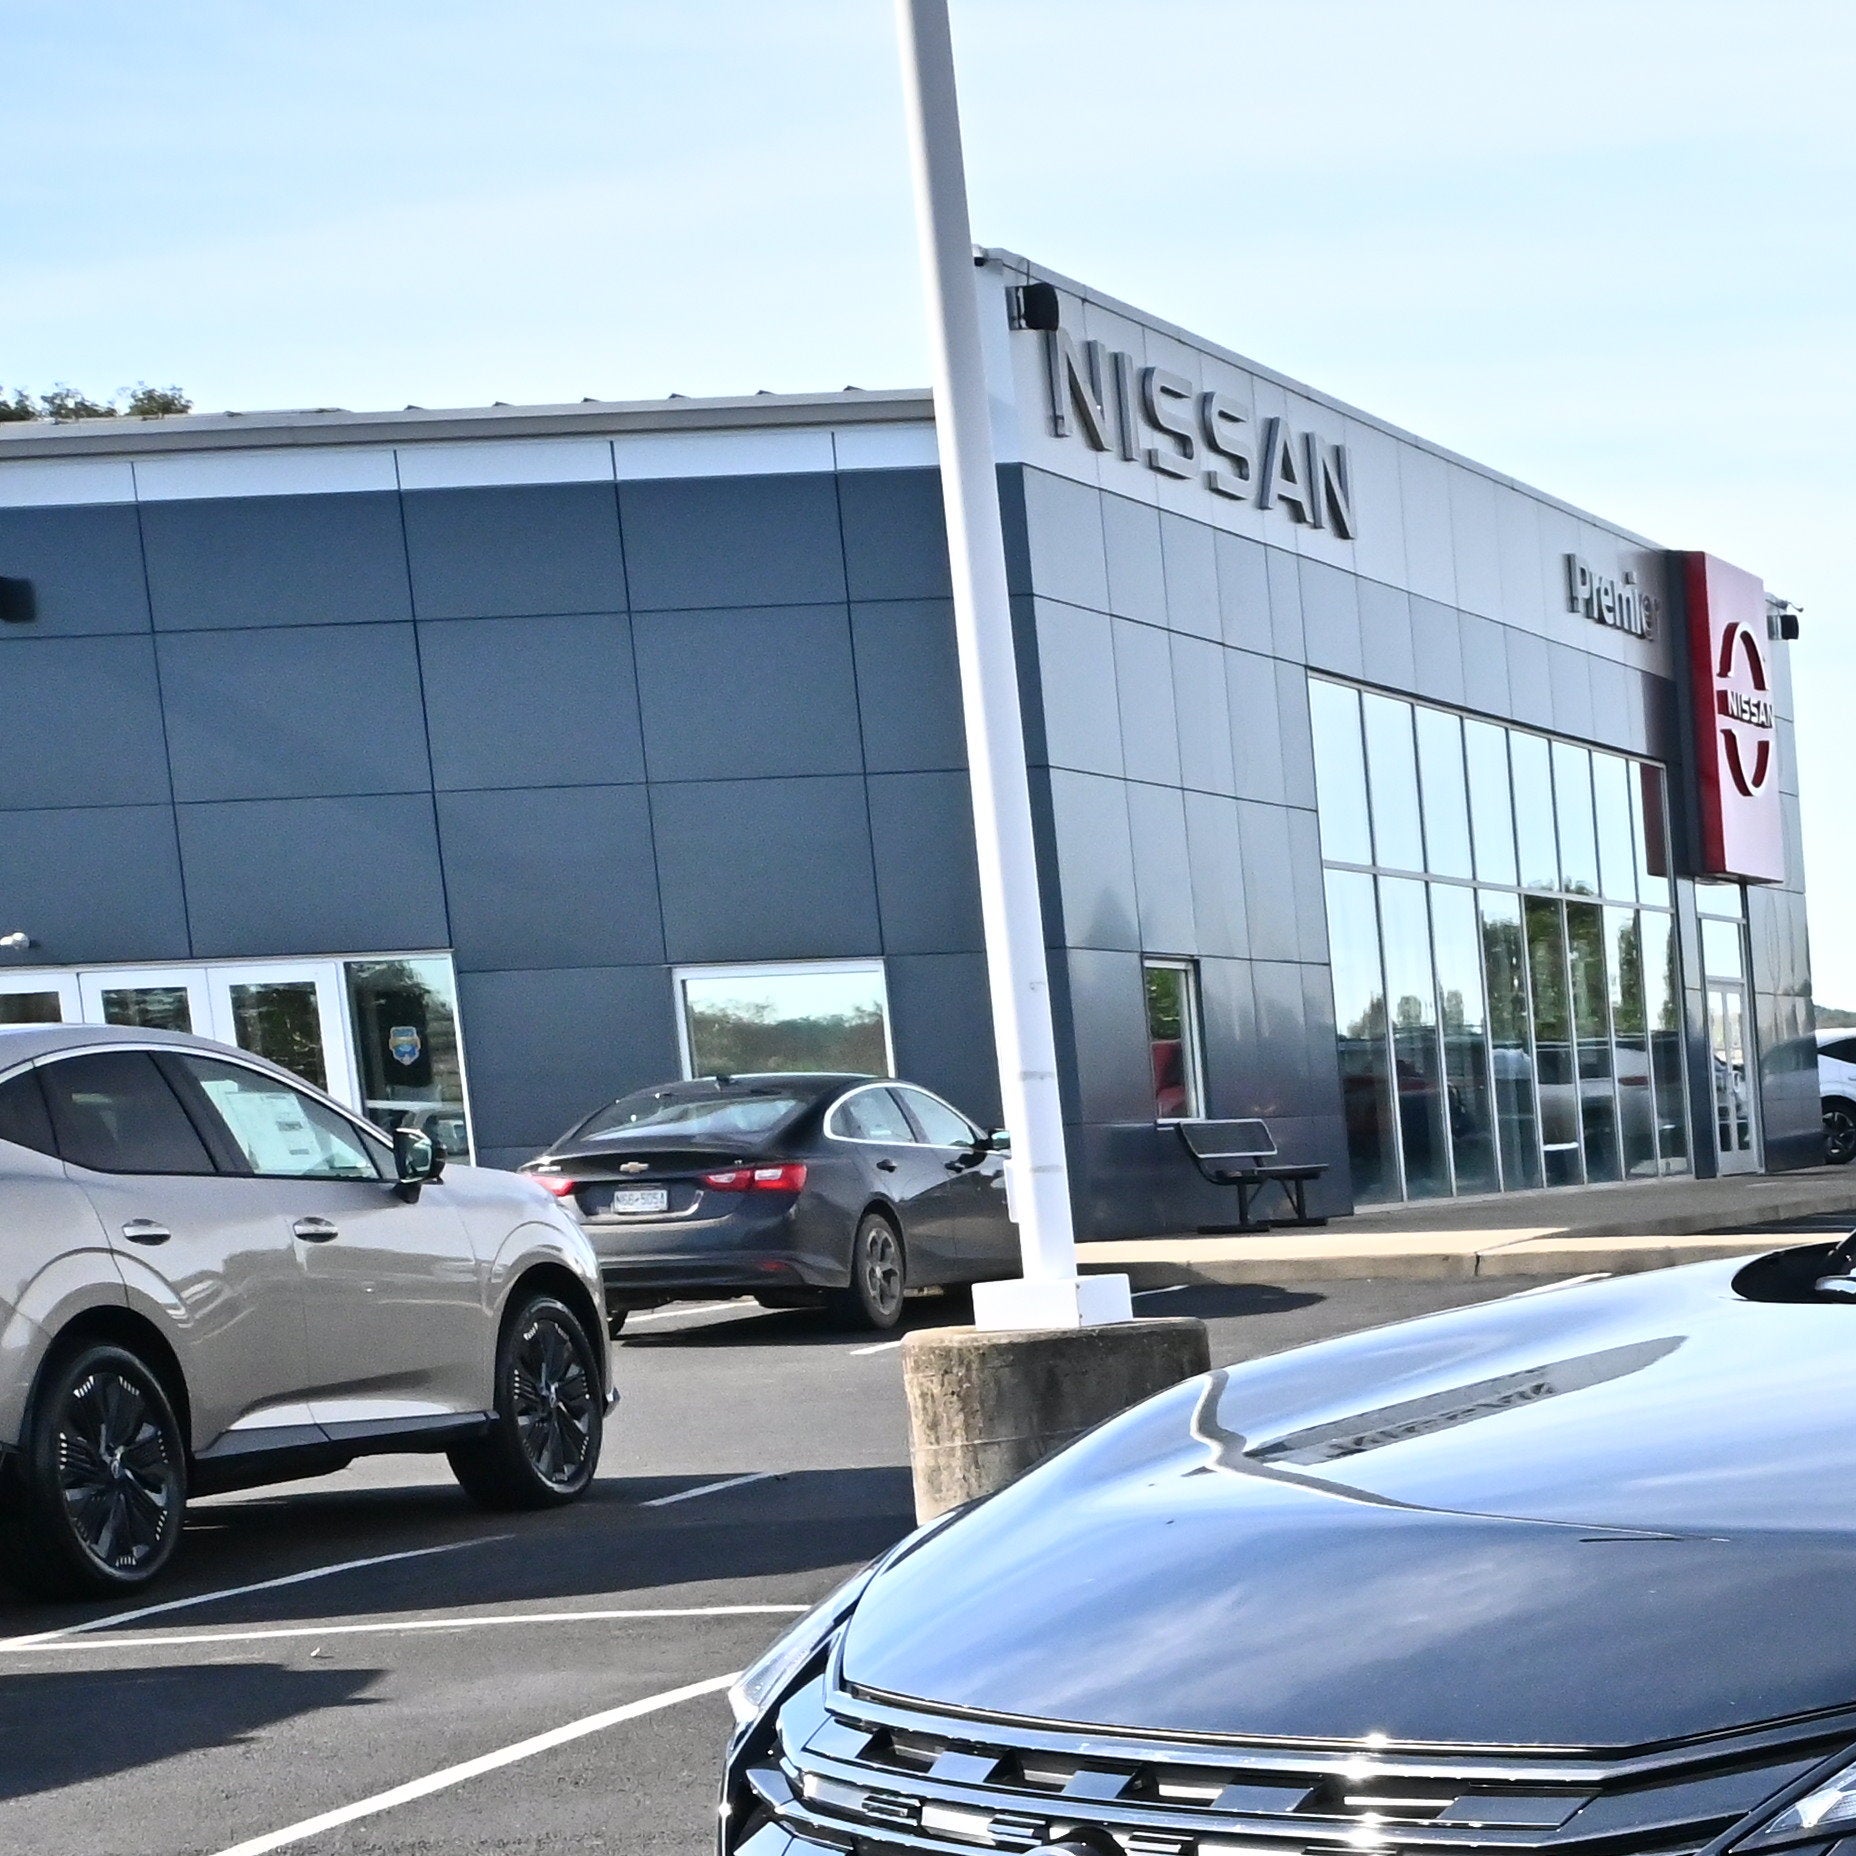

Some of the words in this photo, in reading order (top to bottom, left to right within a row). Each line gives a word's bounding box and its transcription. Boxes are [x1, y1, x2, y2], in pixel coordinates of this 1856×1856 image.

[1047, 327, 1356, 540] NISSAN
[1564, 553, 1661, 641] Premier
[1727, 690, 1773, 728] NISSAN
